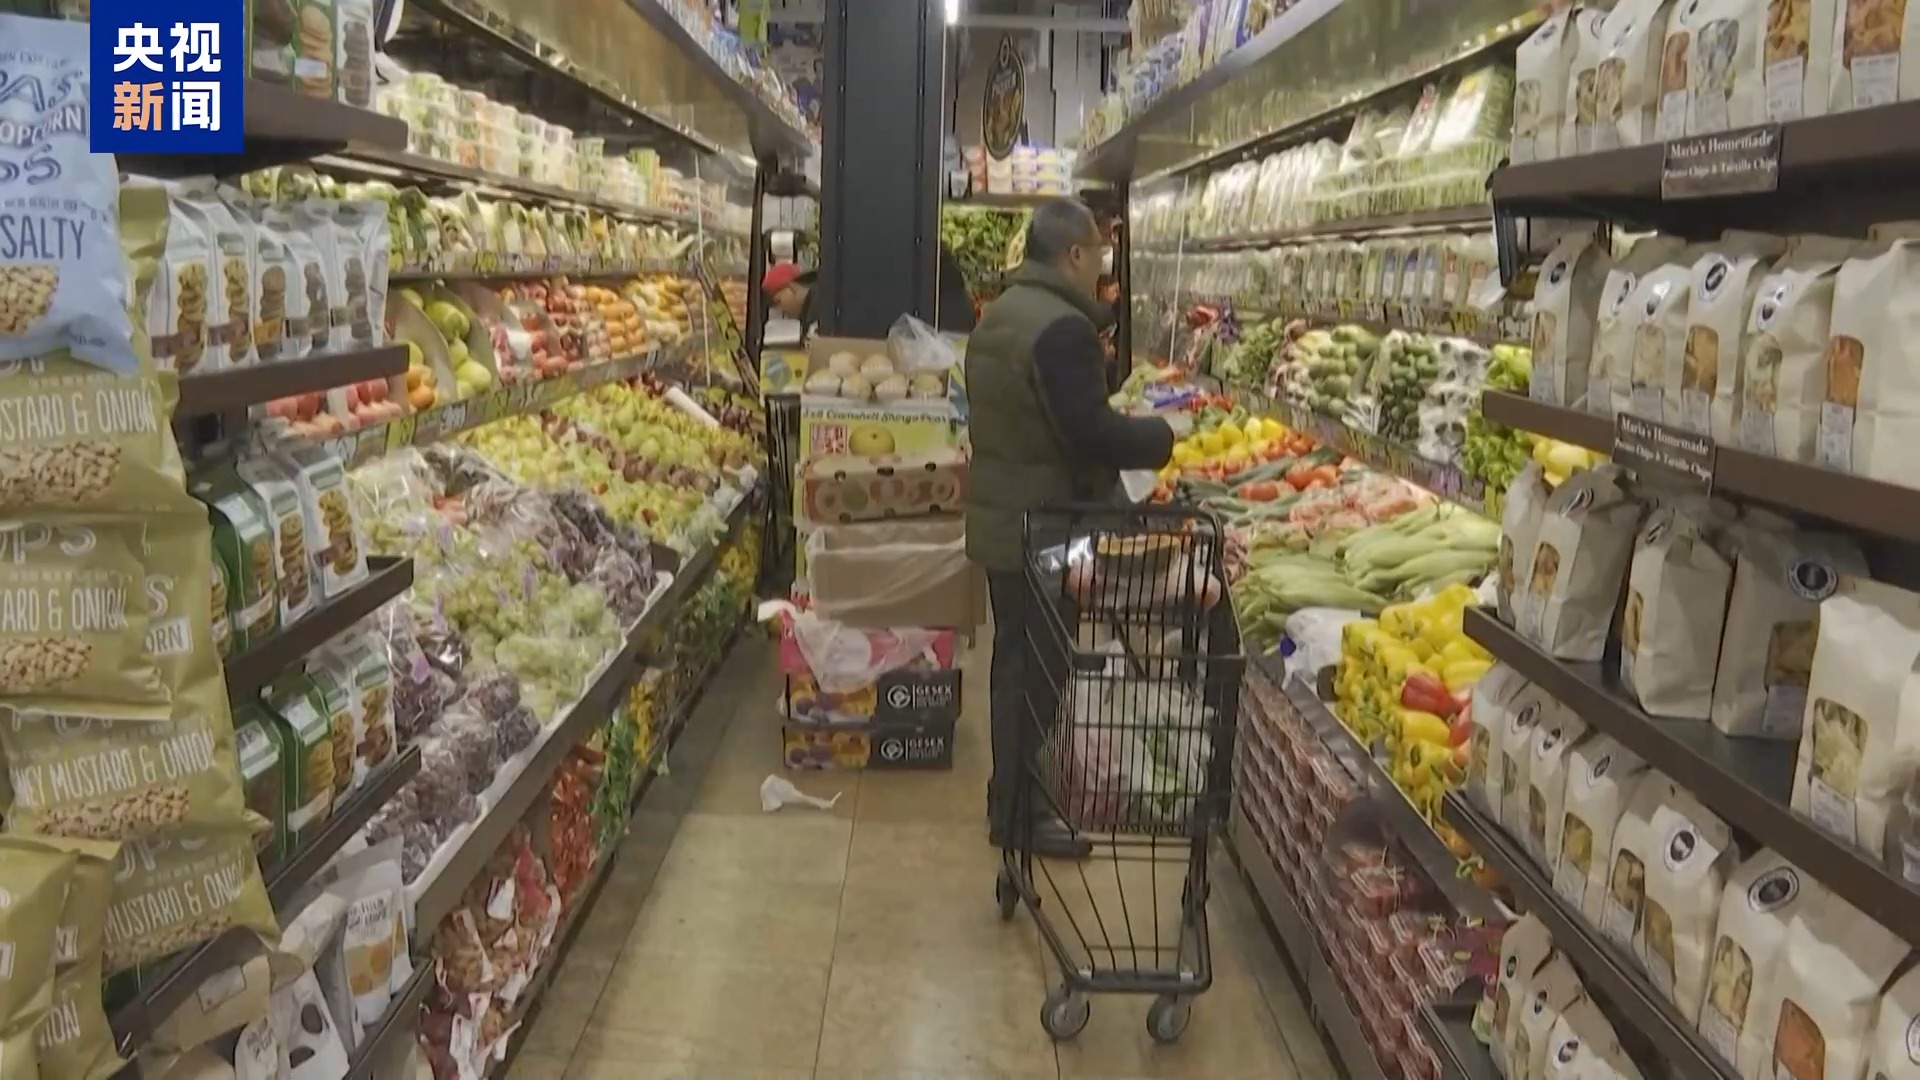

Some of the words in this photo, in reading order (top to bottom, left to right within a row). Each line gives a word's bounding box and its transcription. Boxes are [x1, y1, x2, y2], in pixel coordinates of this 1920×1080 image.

[0, 213, 85, 260] SALTY
[71, 391, 89, 435] &
[47, 588, 62, 632] &
[49, 749, 137, 802] MUSTARD
[138, 744, 157, 784] &
[103, 886, 184, 944] MUSTARD
[183, 880, 202, 916] &
